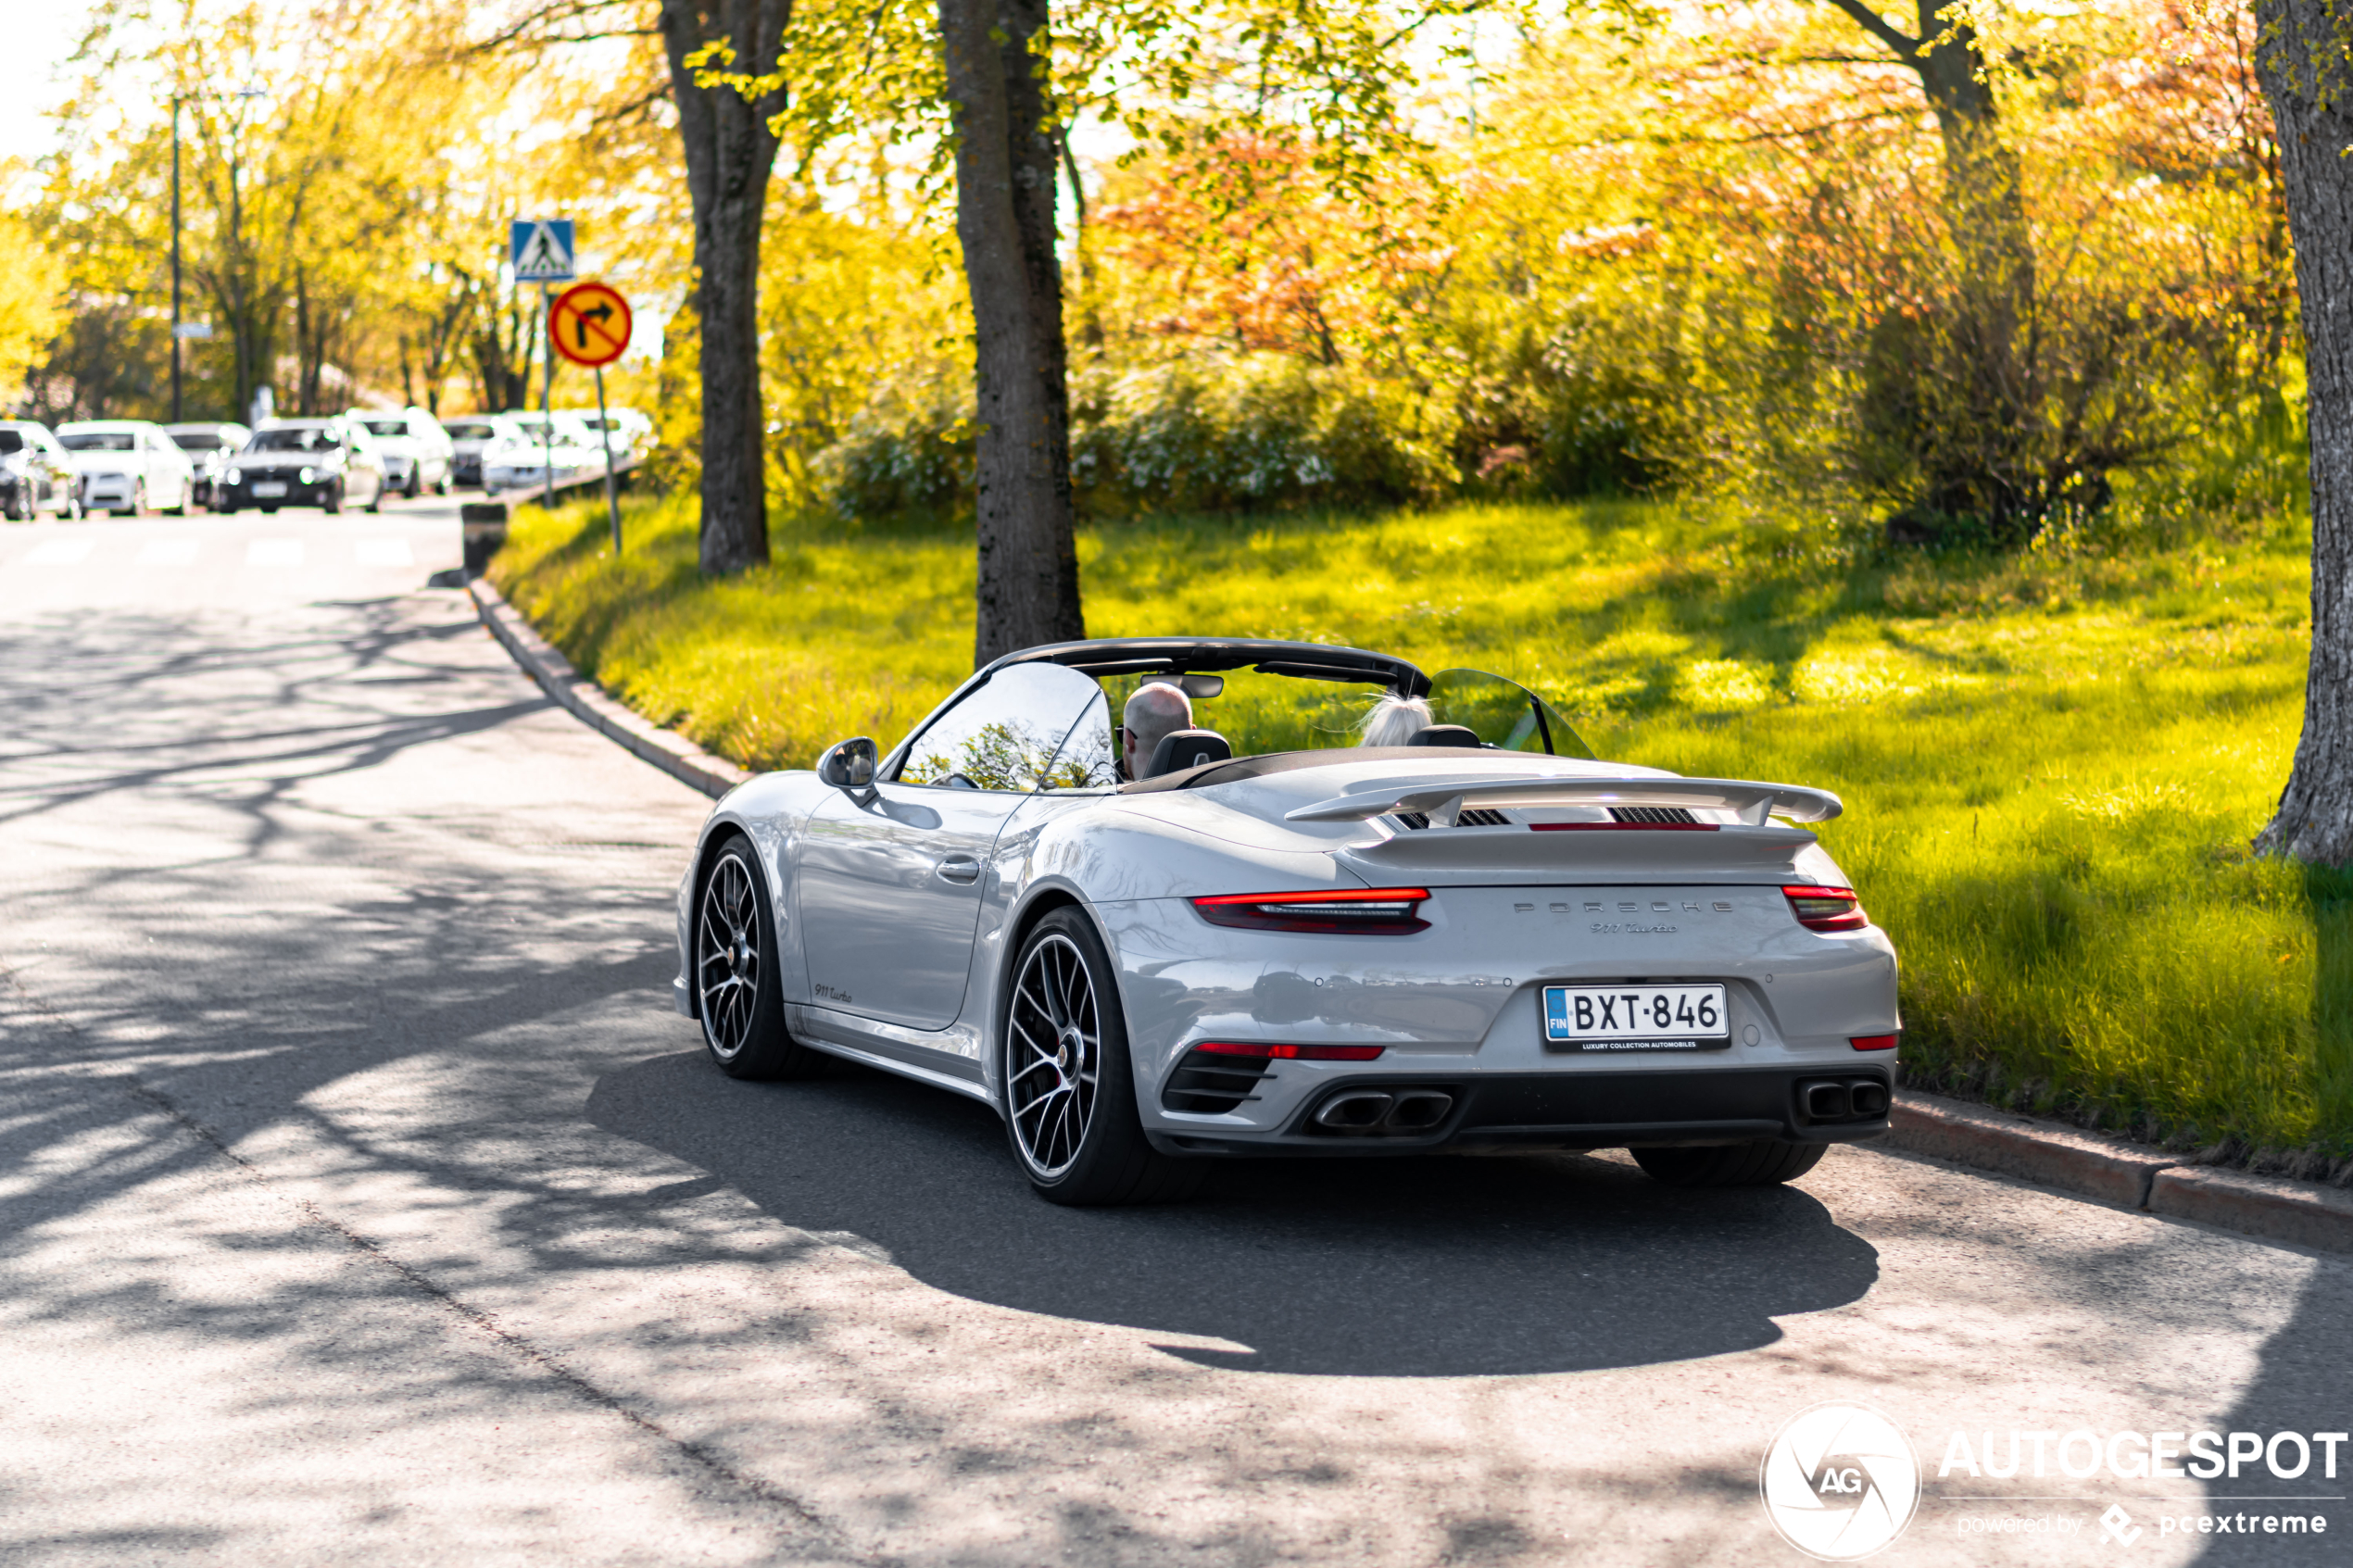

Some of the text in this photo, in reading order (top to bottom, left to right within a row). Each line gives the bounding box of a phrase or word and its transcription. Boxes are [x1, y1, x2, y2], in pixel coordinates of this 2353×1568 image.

[1513, 901, 1733, 914] PORSCHE
[1590, 923, 1679, 934] 911 Turbo
[815, 984, 851, 1002] 911 Turbo
[1550, 1018, 1567, 1029] FIN
